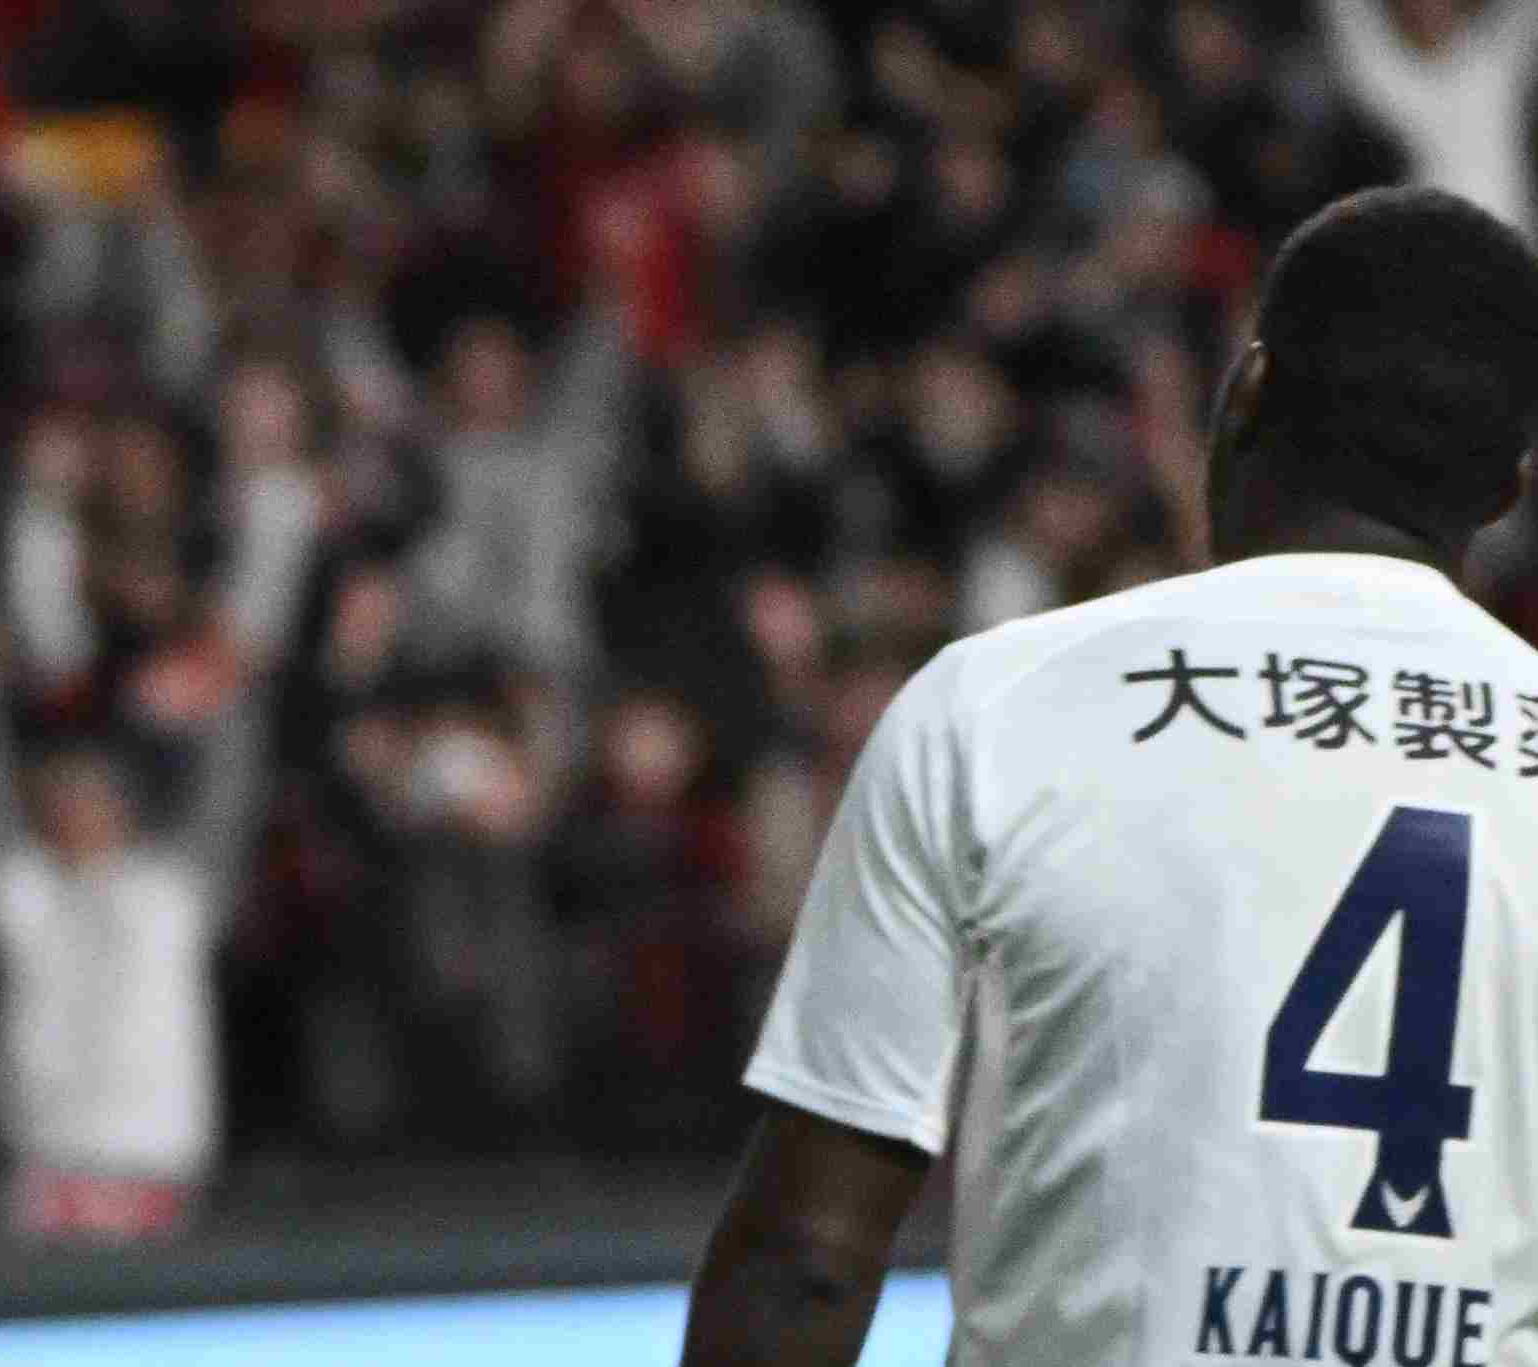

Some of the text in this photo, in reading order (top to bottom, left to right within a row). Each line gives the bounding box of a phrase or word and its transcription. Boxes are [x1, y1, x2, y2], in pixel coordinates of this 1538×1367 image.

[1123, 648, 1538, 778] 大塚製
[1256, 805, 1475, 1240] 4
